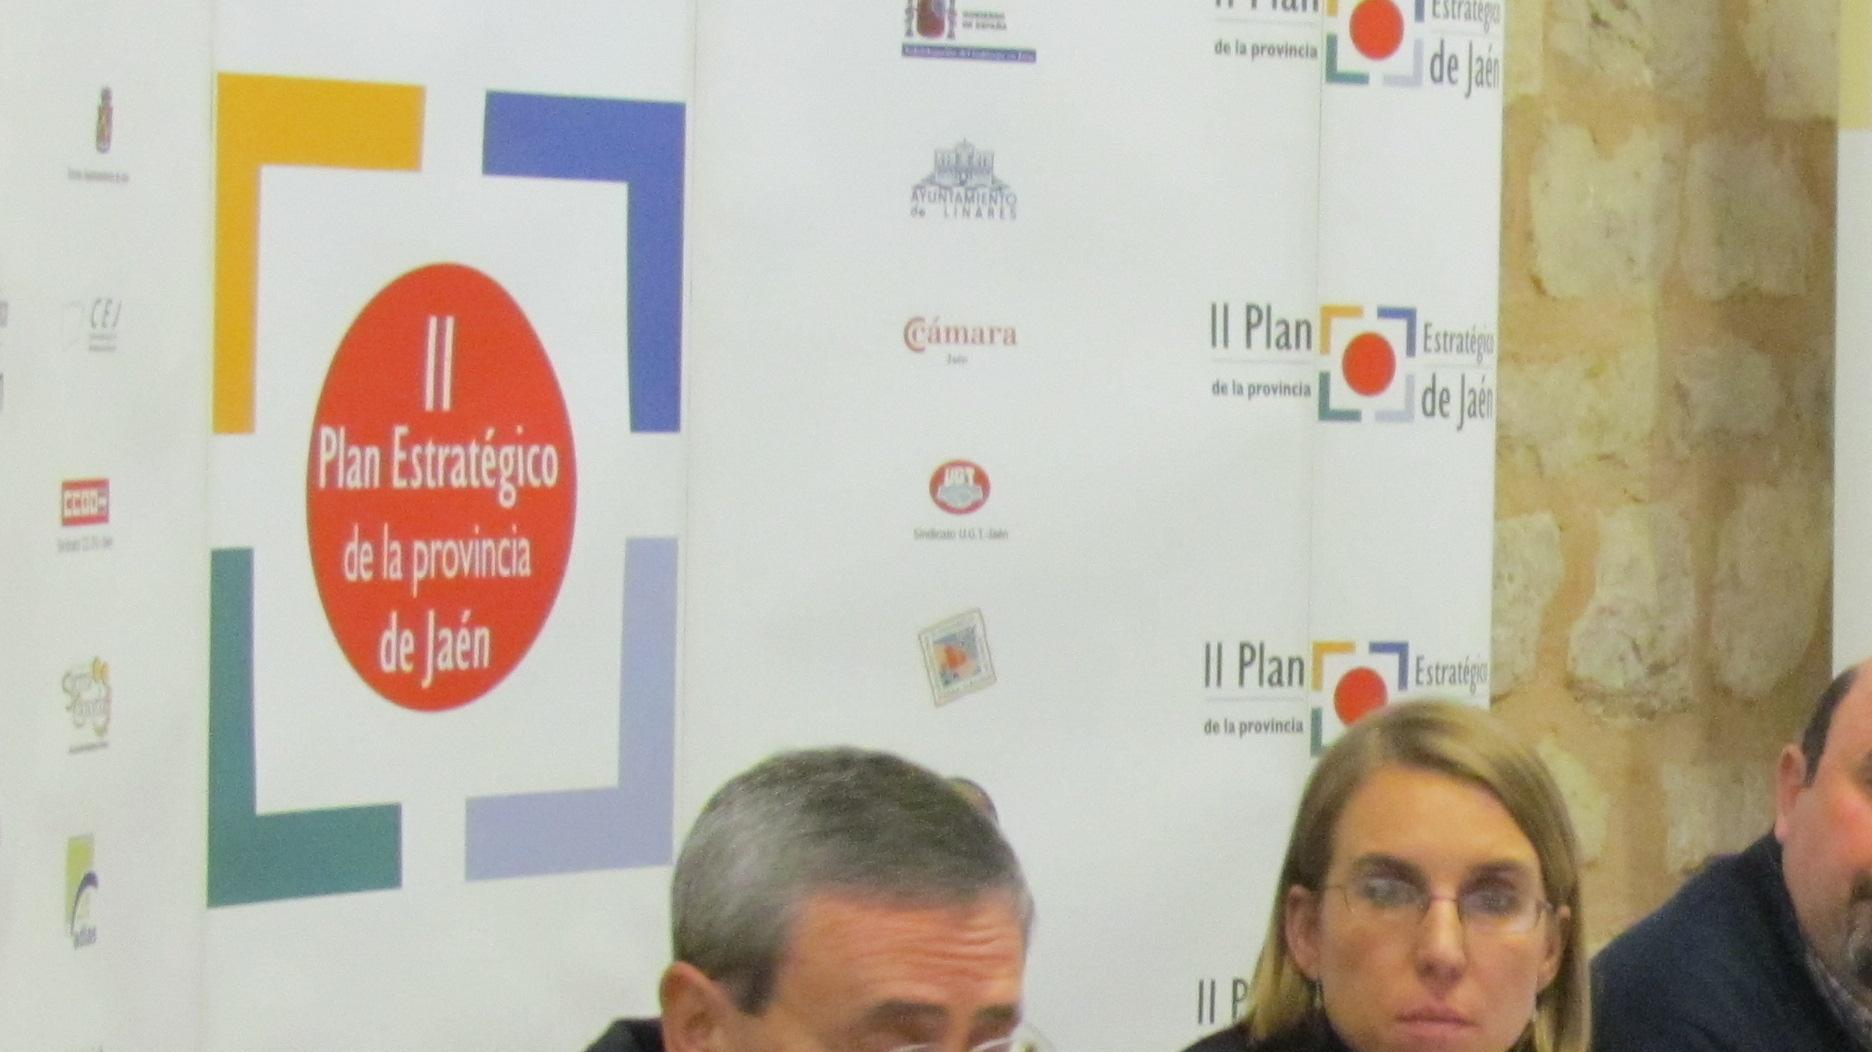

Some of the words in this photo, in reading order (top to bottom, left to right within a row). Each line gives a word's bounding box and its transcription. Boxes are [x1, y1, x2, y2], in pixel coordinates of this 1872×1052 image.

[1214, 38, 1232, 55] de
[1234, 38, 1248, 56] la
[1250, 42, 1319, 61] provincia
[1429, 38, 1459, 85] de
[1465, 39, 1498, 98] Jaén
[1210, 302, 1230, 349] II
[1245, 302, 1313, 351] Plan
[1422, 322, 1496, 364] Estratégico
[423, 315, 455, 412] II
[1211, 379, 1229, 396] de
[1231, 378, 1244, 397] la
[1247, 380, 1312, 401] provincia
[1421, 372, 1451, 419] de
[1456, 371, 1494, 431] Jaén
[316, 424, 381, 491] Plan
[390, 424, 560, 509] Estratégico
[342, 523, 375, 582] de
[380, 522, 404, 581] la
[410, 523, 532, 598] provincia
[378, 610, 415, 674] de
[421, 610, 491, 688] Jaén
[1204, 642, 1223, 689] II
[1238, 641, 1305, 688] Plan
[1414, 655, 1489, 695] Estratégico
[1203, 718, 1220, 735] de
[1223, 717, 1236, 735] la
[1238, 716, 1305, 739] provincia
